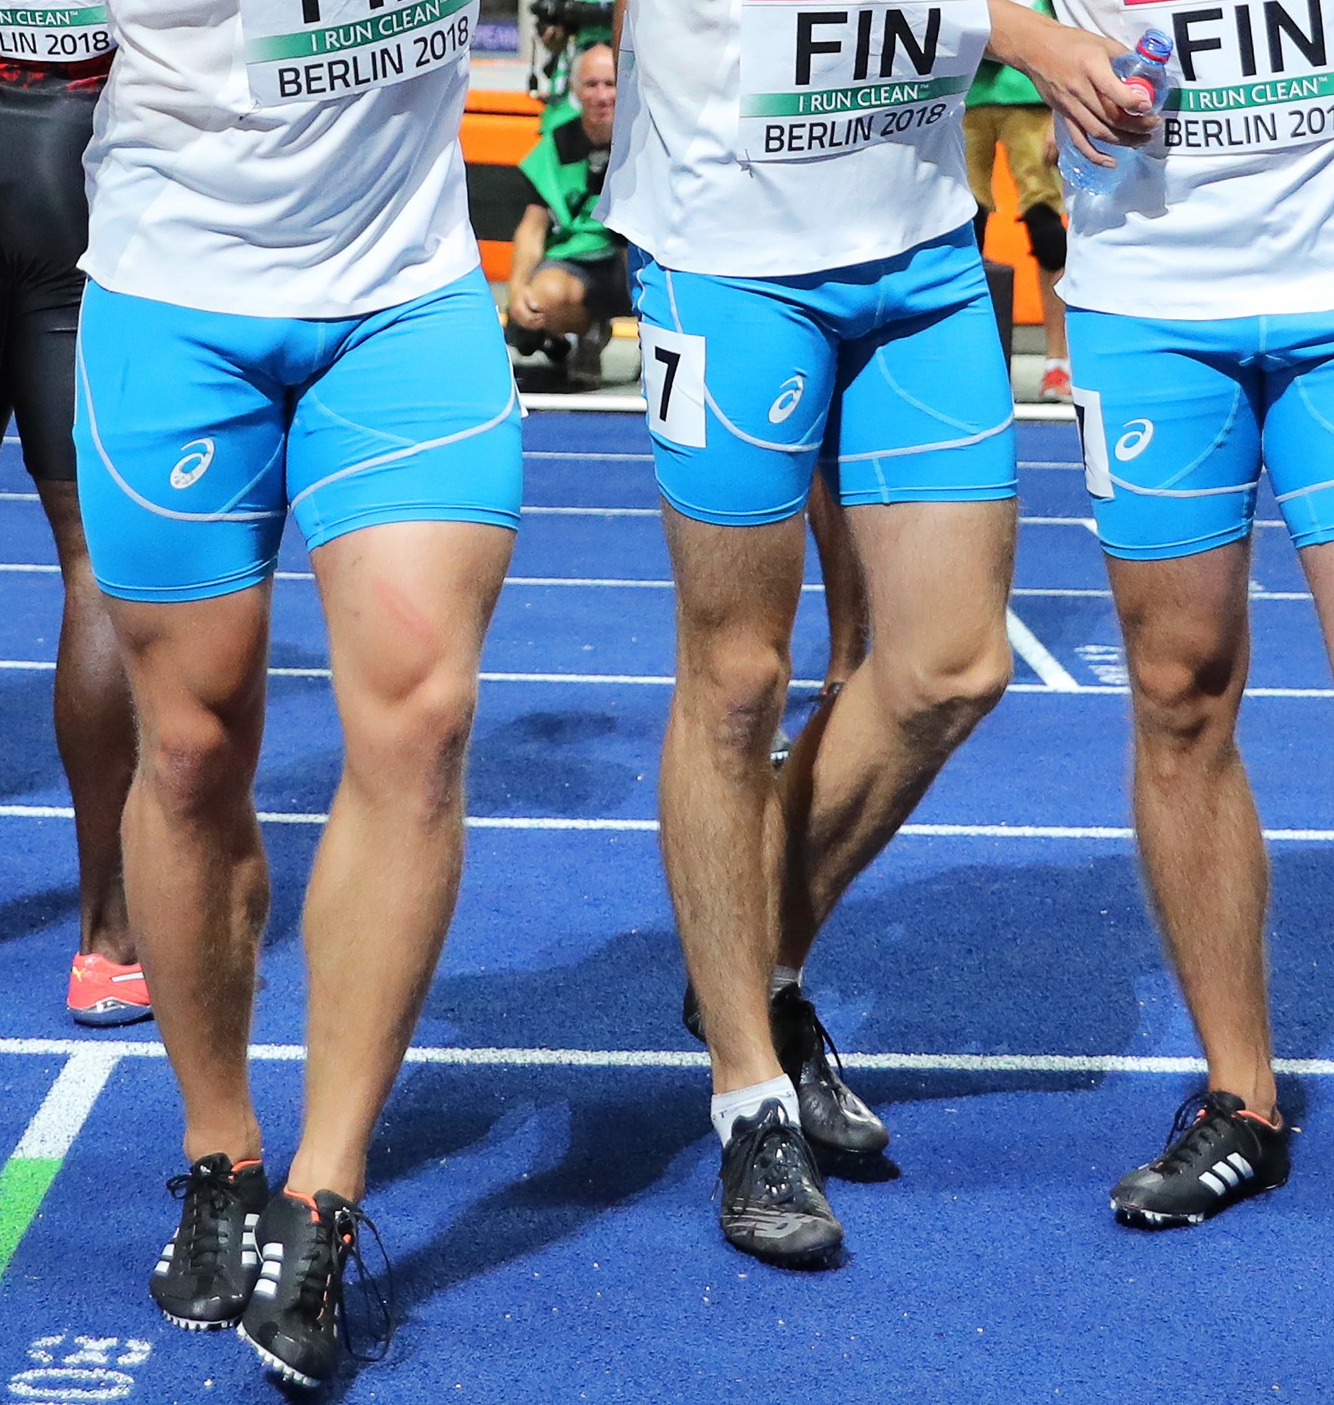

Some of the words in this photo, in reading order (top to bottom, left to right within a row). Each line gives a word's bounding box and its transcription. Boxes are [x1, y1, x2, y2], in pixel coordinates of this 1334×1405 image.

[45, 30, 110, 56] 2018
[310, 34, 317, 52] I
[325, 22, 372, 50] RUN
[794, 7, 941, 86] FIN
[278, 43, 404, 98] BERLIN
[413, 15, 468, 69] 2018
[798, 95, 804, 112] I
[811, 91, 851, 112] RUN
[1189, 93, 1194, 109] I
[1200, 88, 1247, 109] RUN
[764, 115, 875, 154] BERLIN
[880, 102, 947, 138] 2018
[1164, 111, 1278, 147] BERLIN
[654, 345, 681, 423] 7
